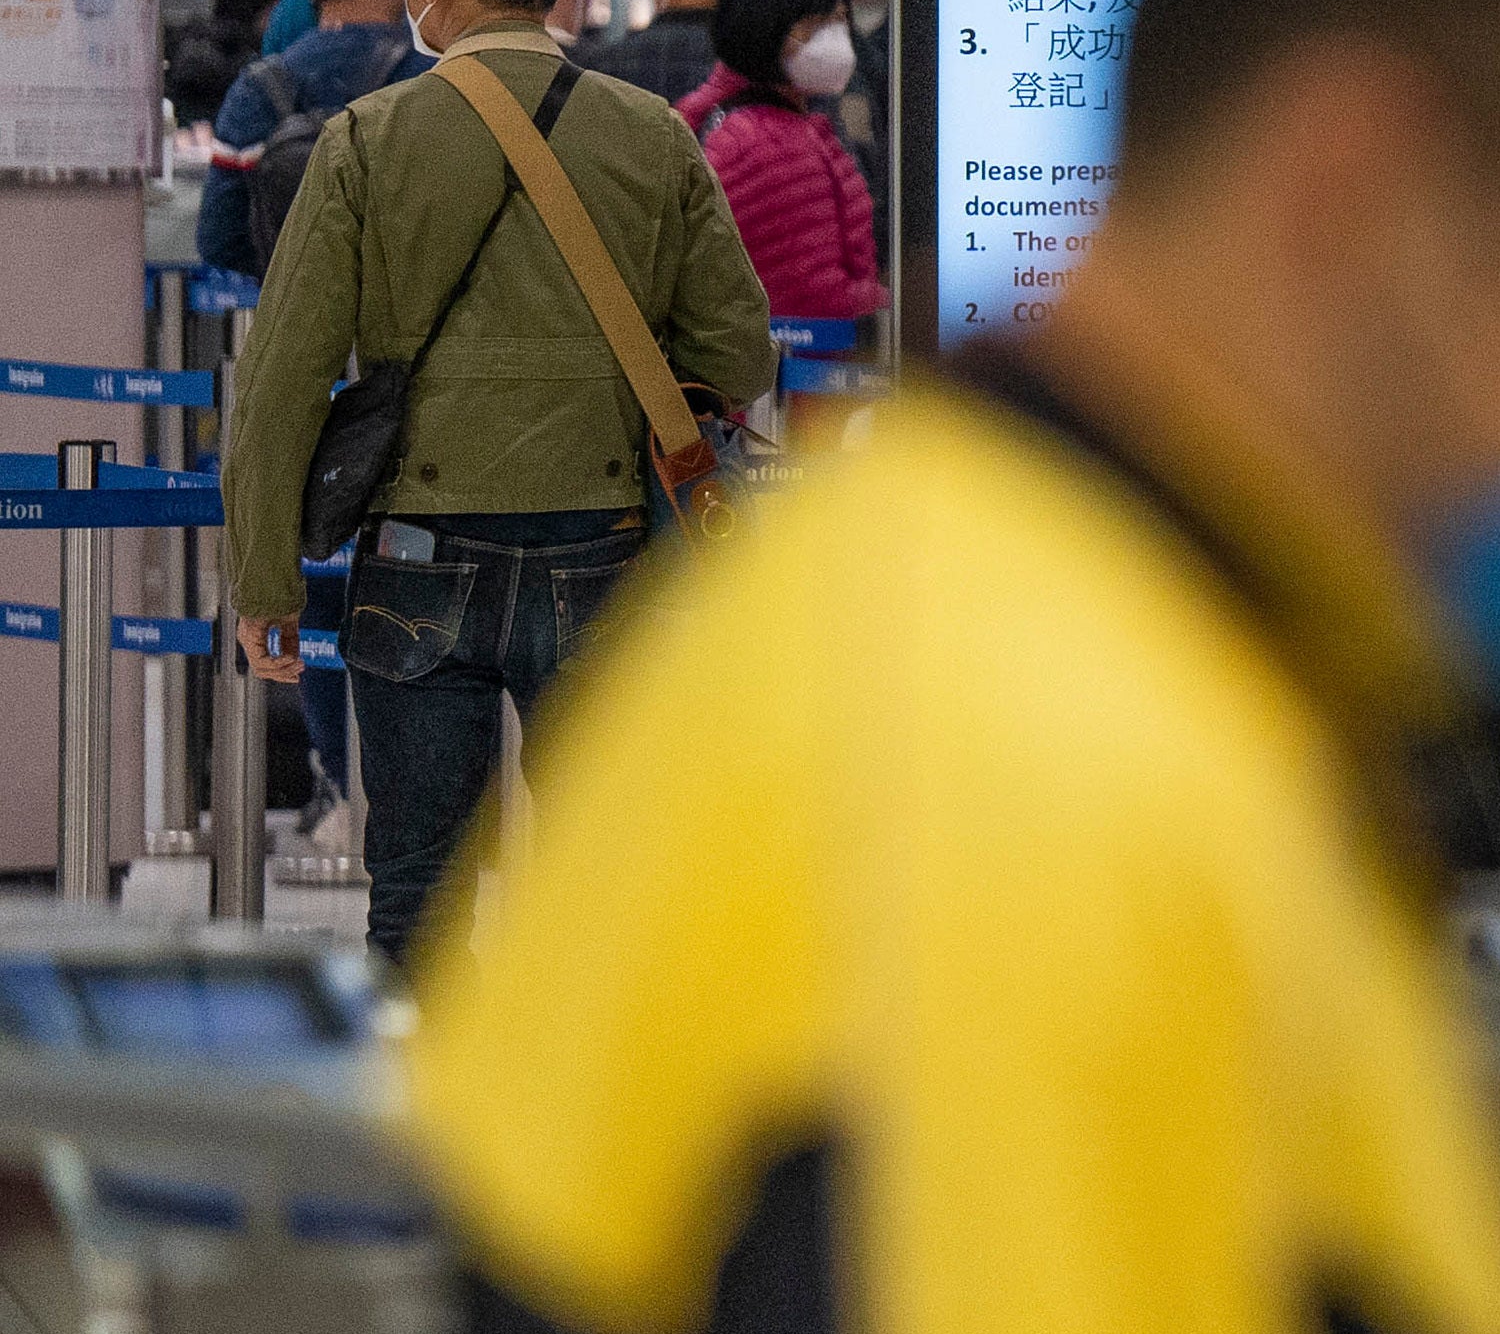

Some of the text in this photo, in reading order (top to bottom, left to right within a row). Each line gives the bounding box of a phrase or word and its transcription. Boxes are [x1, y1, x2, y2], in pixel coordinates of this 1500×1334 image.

[959, 28, 988, 56] 3.
[965, 160, 1043, 181] Please
[965, 195, 1100, 217] documents
[966, 231, 987, 252] 1.
[1013, 231, 1057, 252] The
[965, 302, 987, 323] 2.
